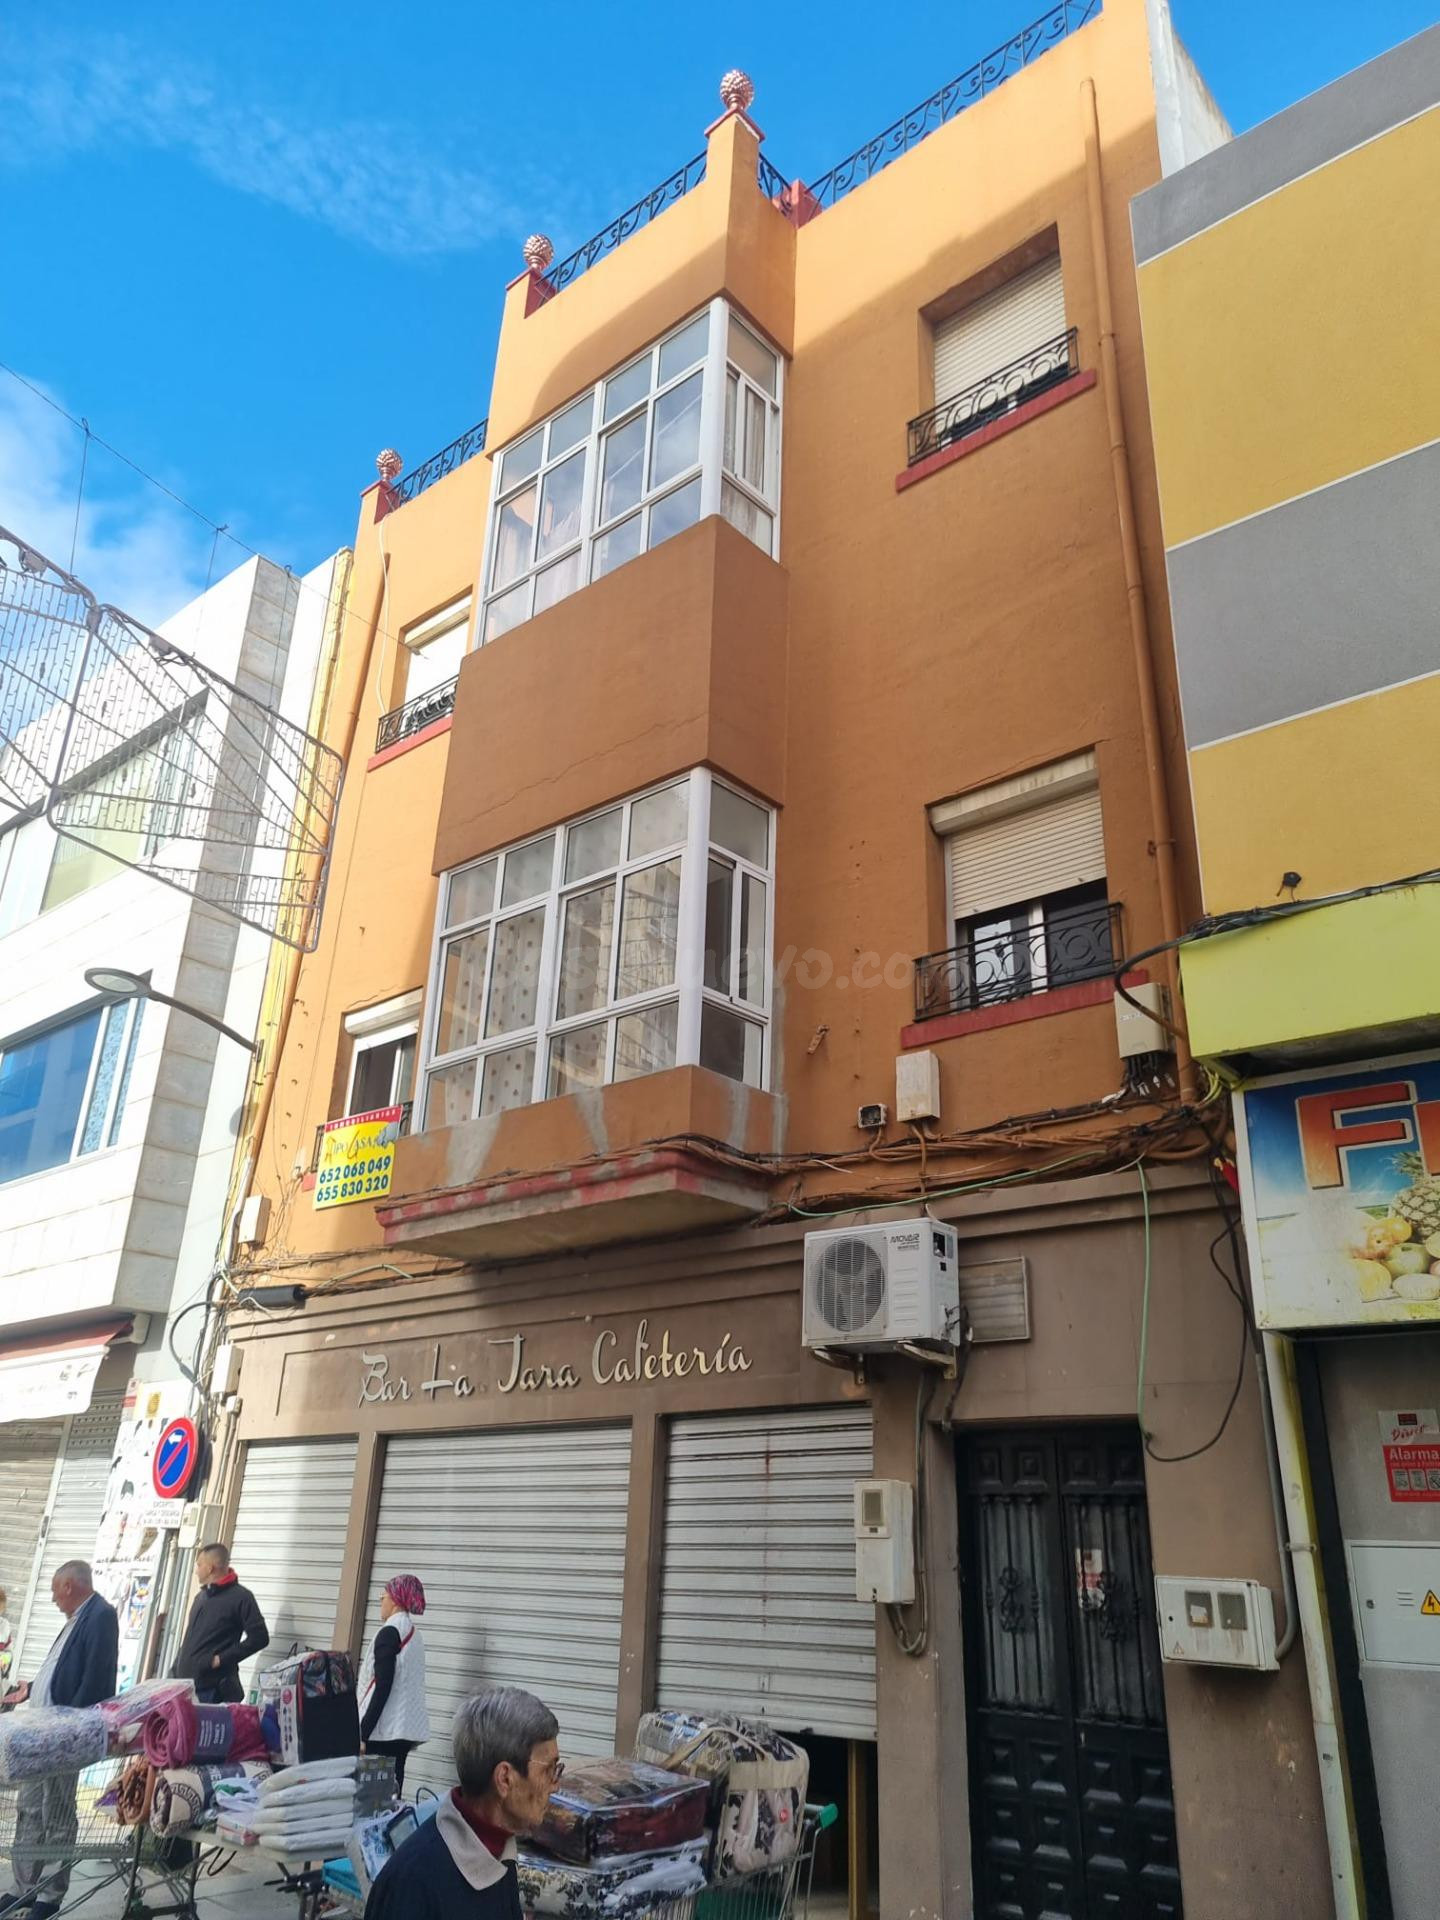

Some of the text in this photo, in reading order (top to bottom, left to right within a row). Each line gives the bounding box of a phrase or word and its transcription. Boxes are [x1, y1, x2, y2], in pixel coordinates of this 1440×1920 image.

[319, 1155, 391, 1184] 652 068 049
[316, 1174, 389, 1202] 655 830 320
[359, 1319, 753, 1408] Bar La Jara Cafetería
[1389, 1447, 1440, 1461] Alarma
